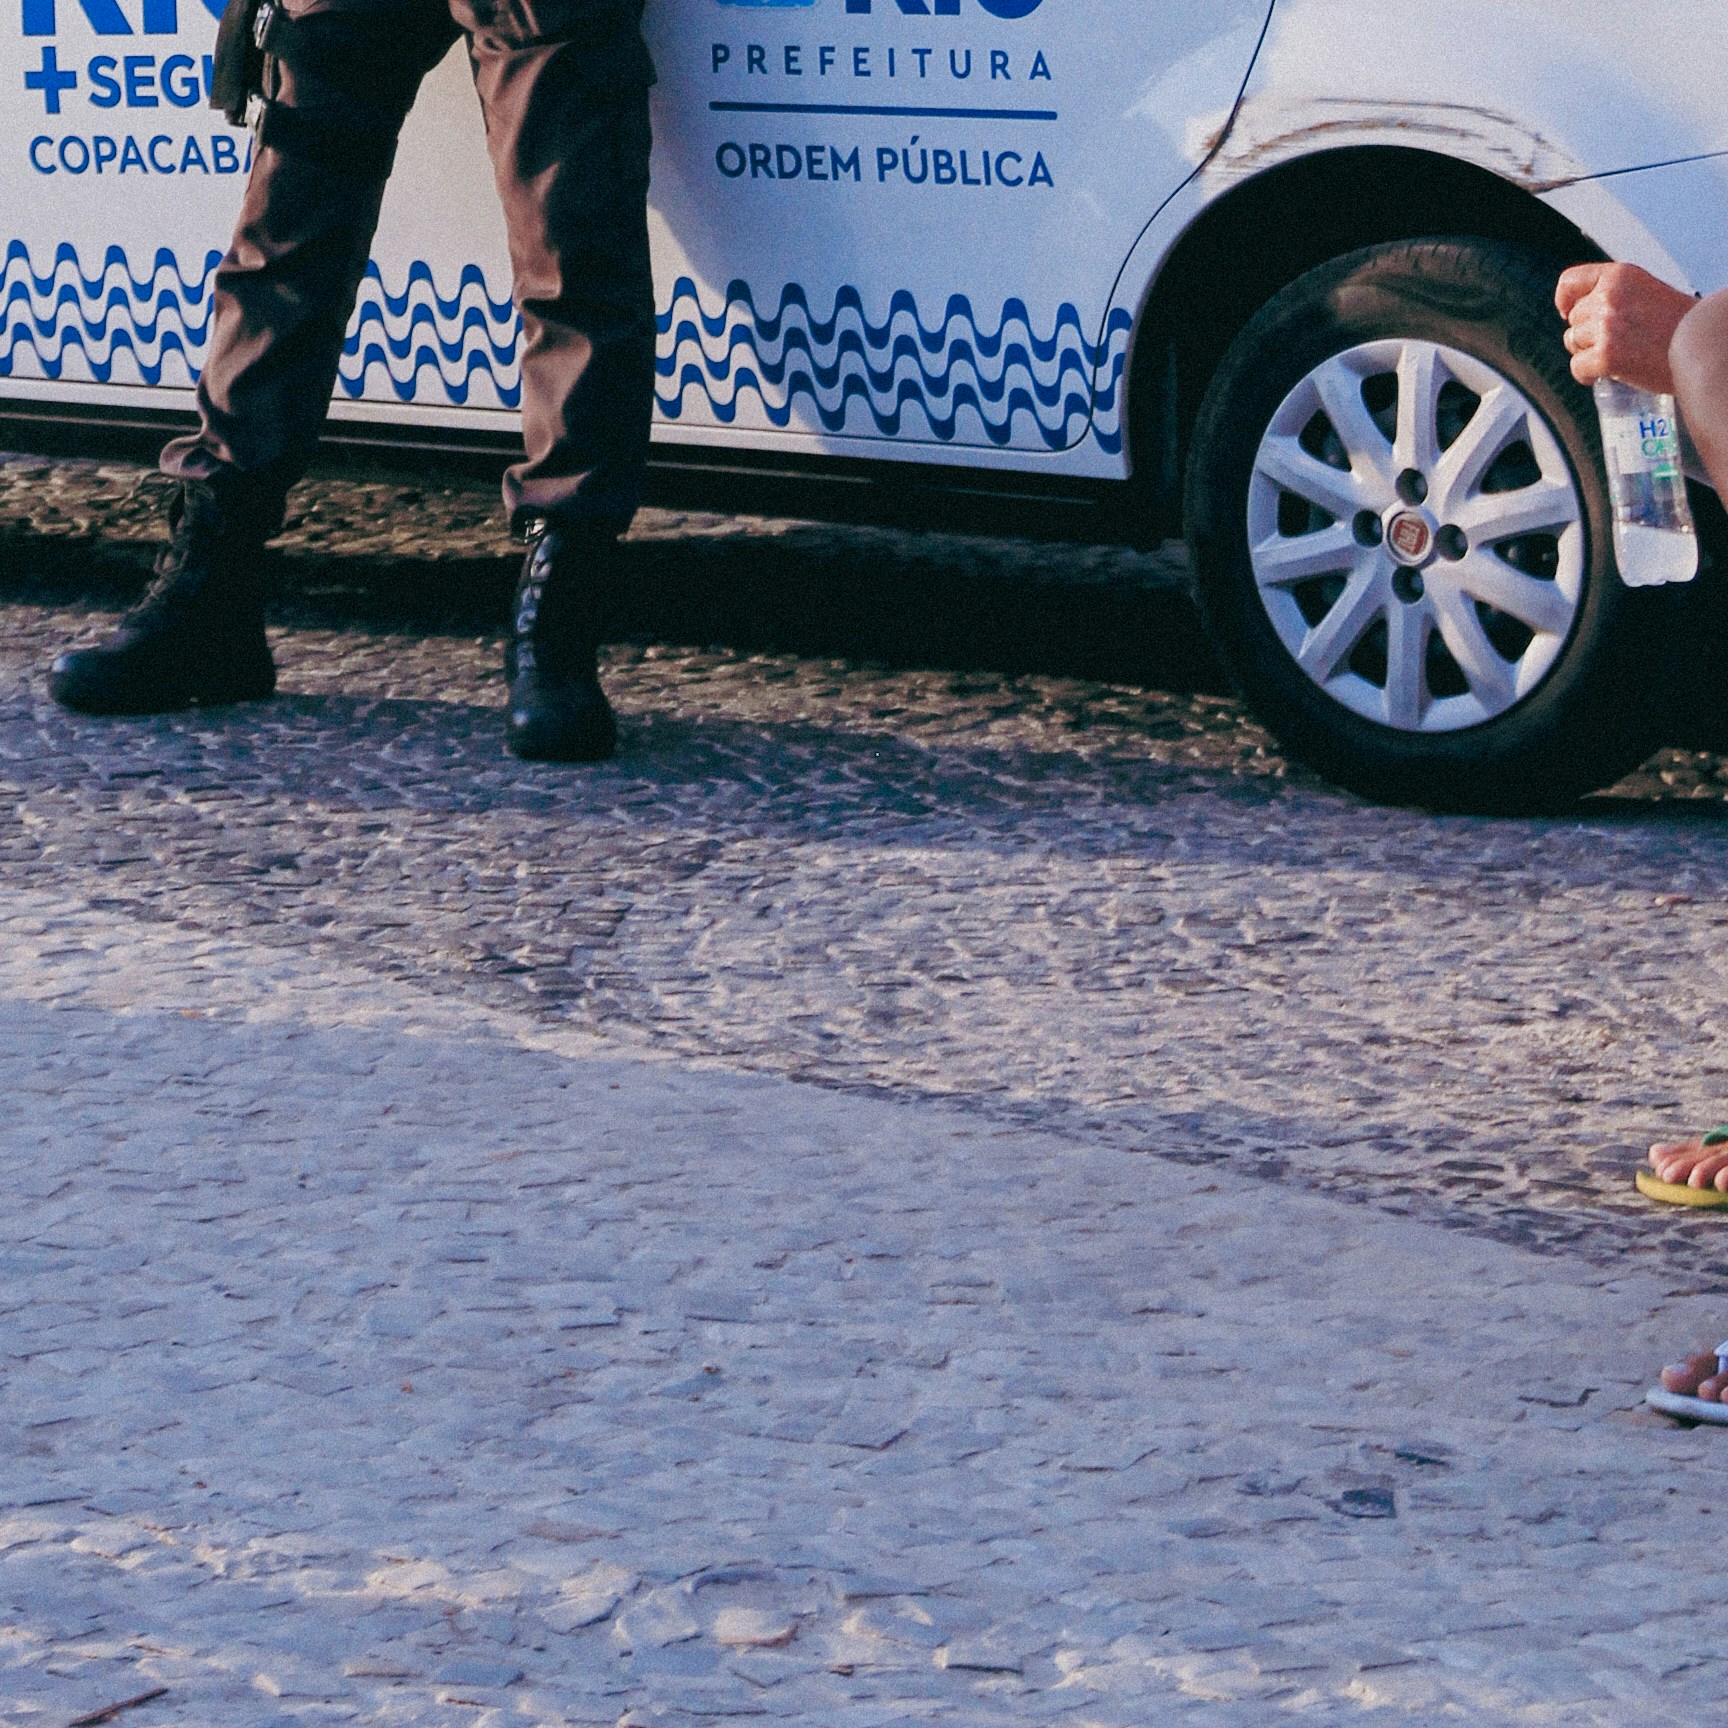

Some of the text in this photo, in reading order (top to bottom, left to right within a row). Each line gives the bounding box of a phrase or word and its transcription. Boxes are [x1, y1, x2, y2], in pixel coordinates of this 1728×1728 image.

[710, 43, 1052, 81] PREFEITURA
[715, 135, 1054, 188] ORDEM PÚBLICA
